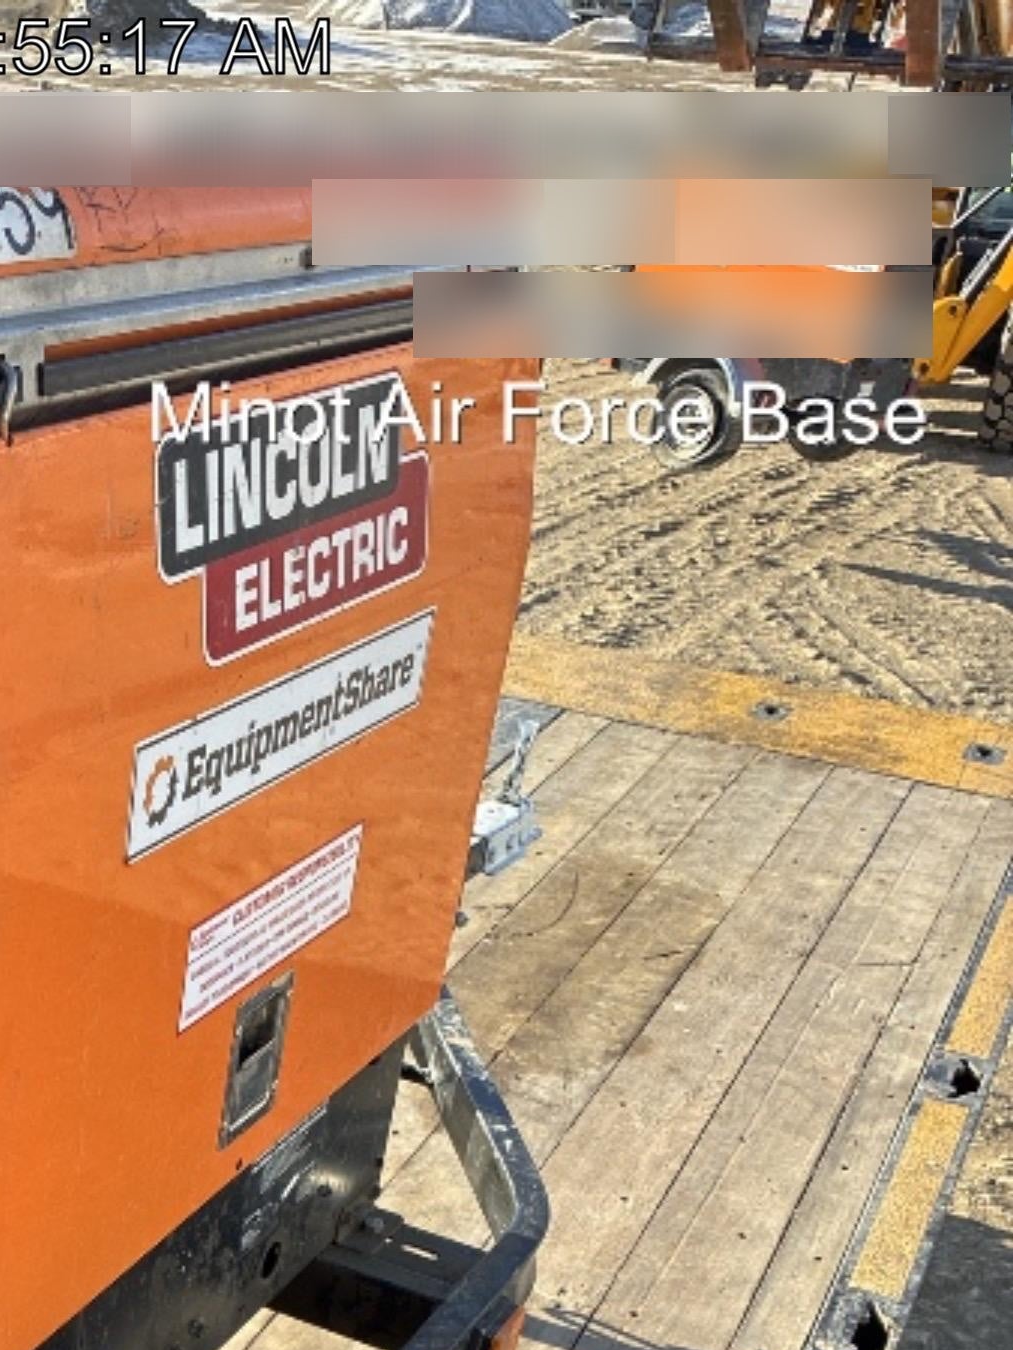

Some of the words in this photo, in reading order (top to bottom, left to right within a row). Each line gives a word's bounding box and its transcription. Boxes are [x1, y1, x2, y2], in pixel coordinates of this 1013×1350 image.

[172, 404, 392, 554] LINCOLN
[234, 505, 409, 633] ELECTRIC
[181, 650, 416, 802] EquipmentShare
